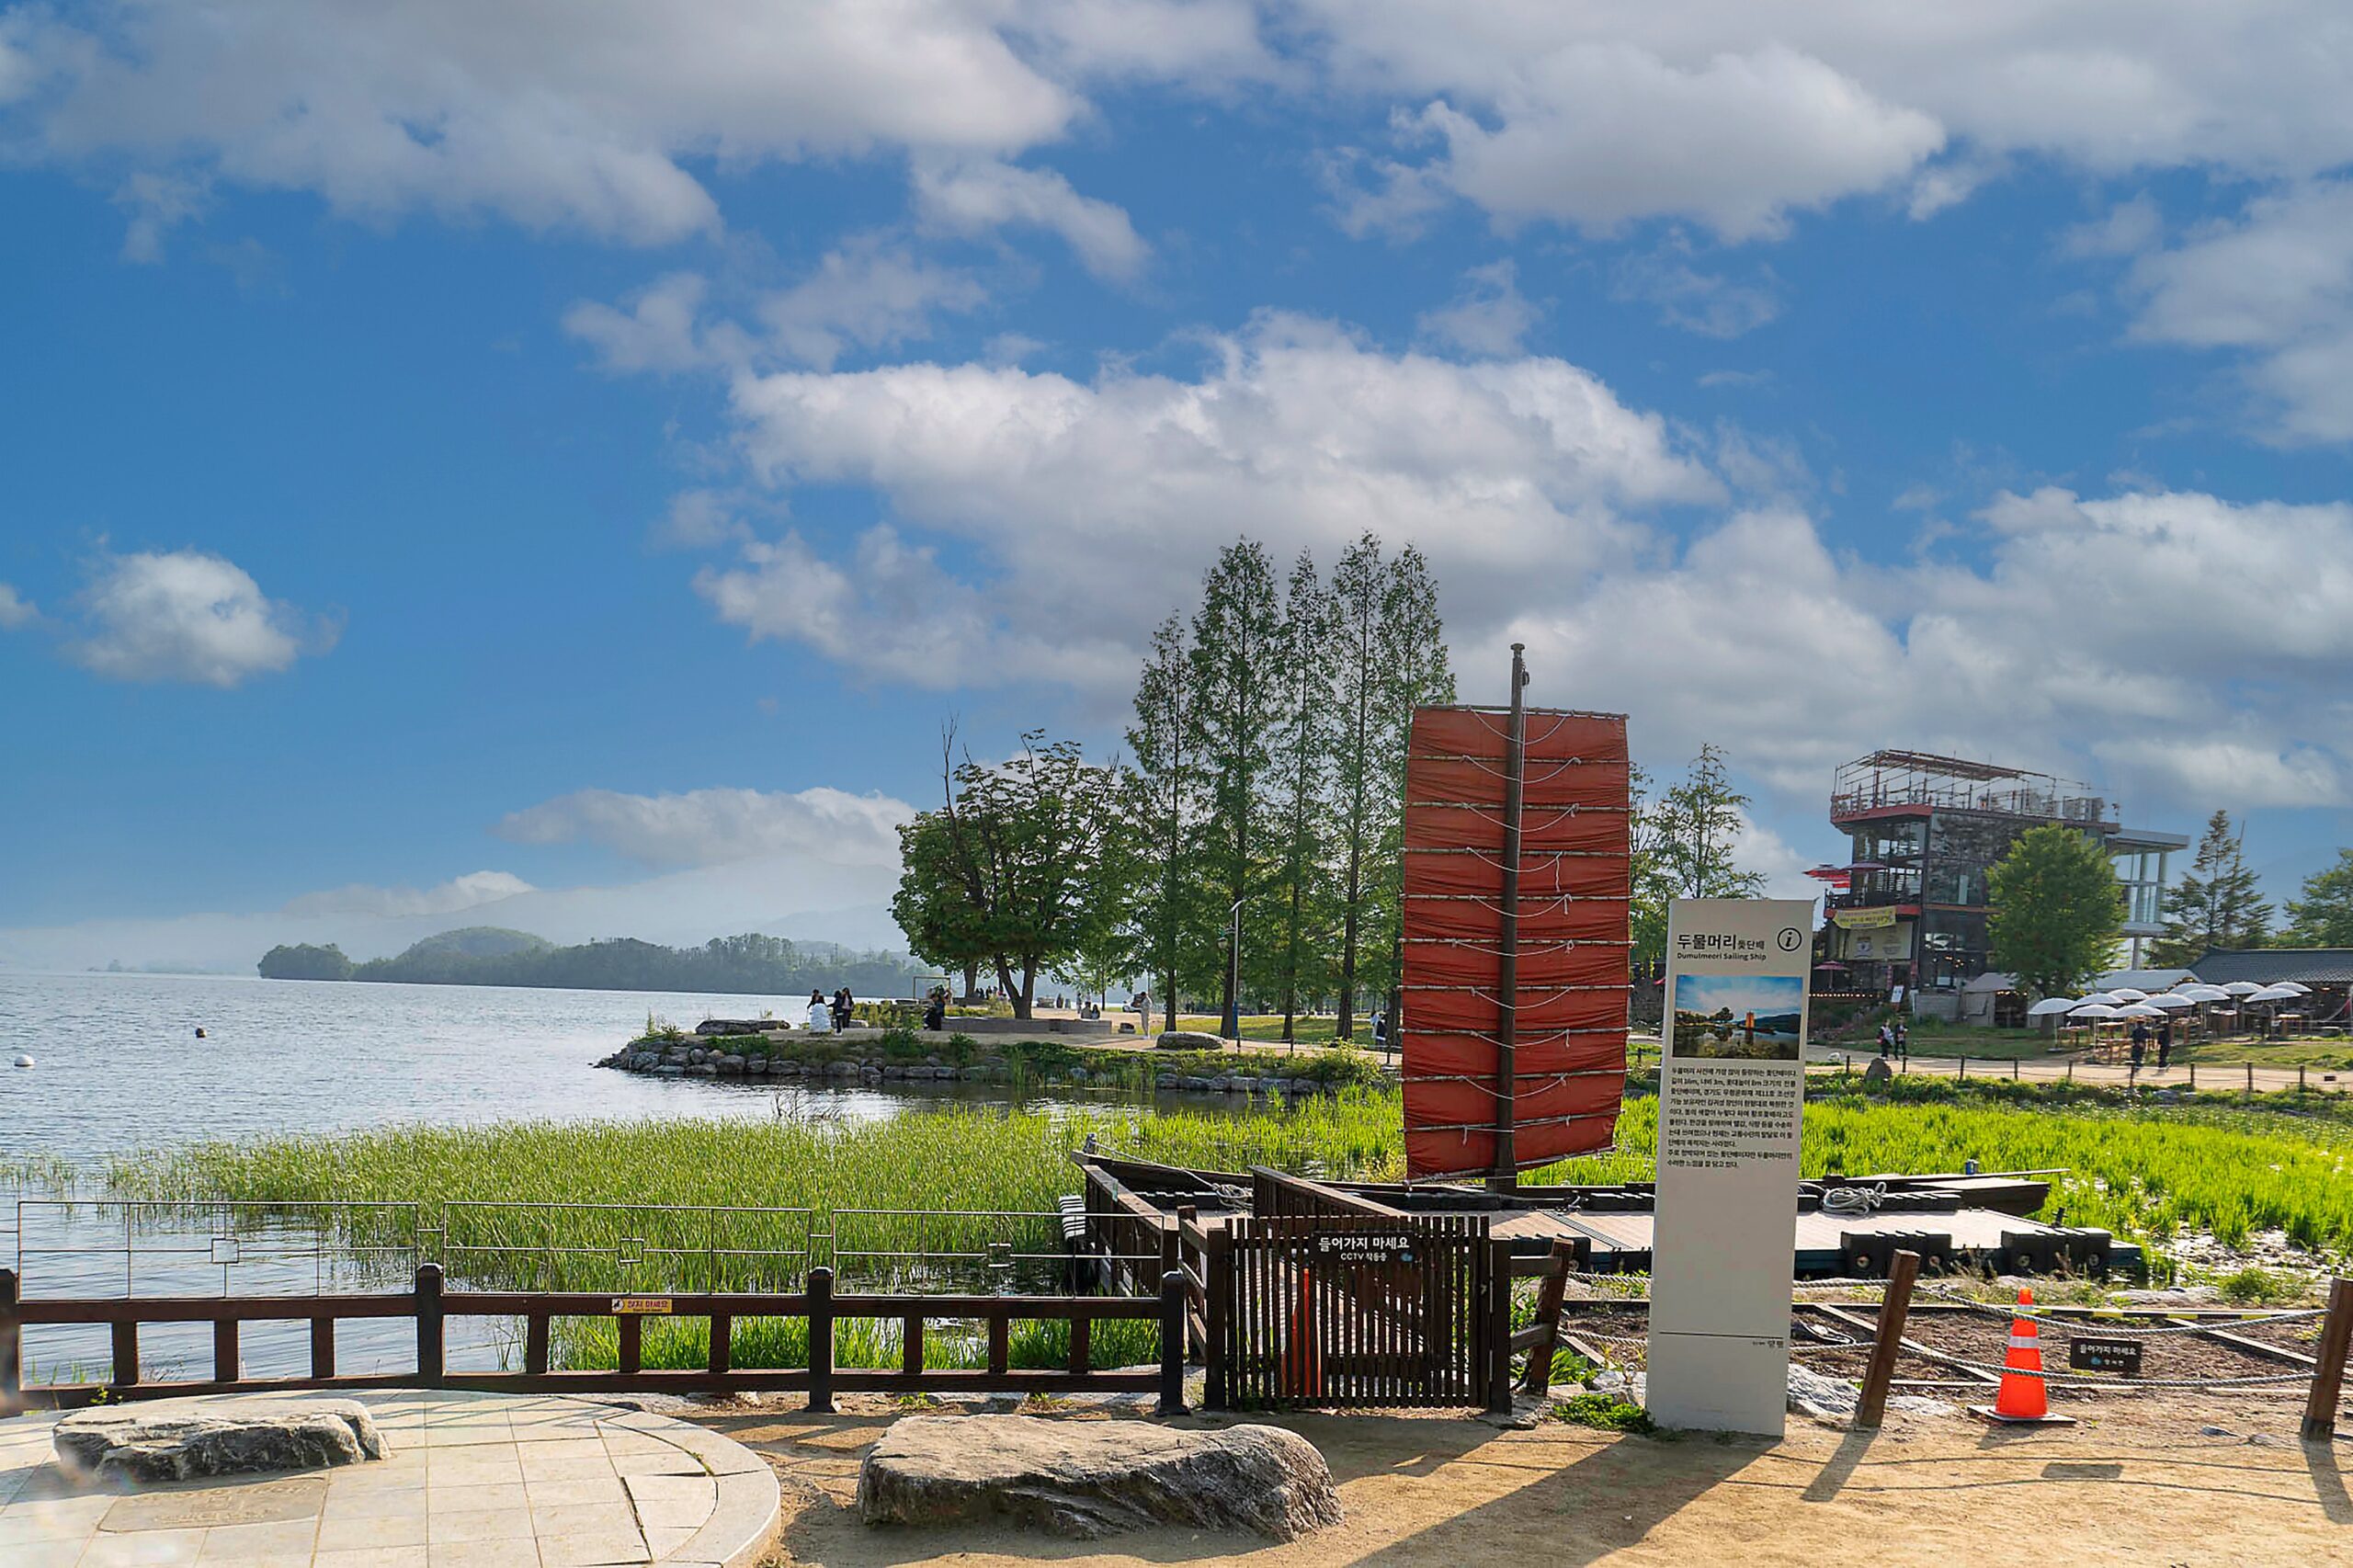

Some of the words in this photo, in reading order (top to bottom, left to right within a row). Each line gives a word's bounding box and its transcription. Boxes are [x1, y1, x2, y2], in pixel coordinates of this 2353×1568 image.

[1677, 934, 1737, 950] 두물머리
[1723, 953, 1748, 961] Sailing
[1749, 953, 1767, 961] Ship
[1318, 1236, 1369, 1253] 들어가지
[1372, 1236, 1411, 1251] 마세요
[1340, 1252, 1365, 1261] CCTV
[2080, 1344, 2111, 1355] 들어가지
[2112, 1346, 2137, 1356] 마세요
